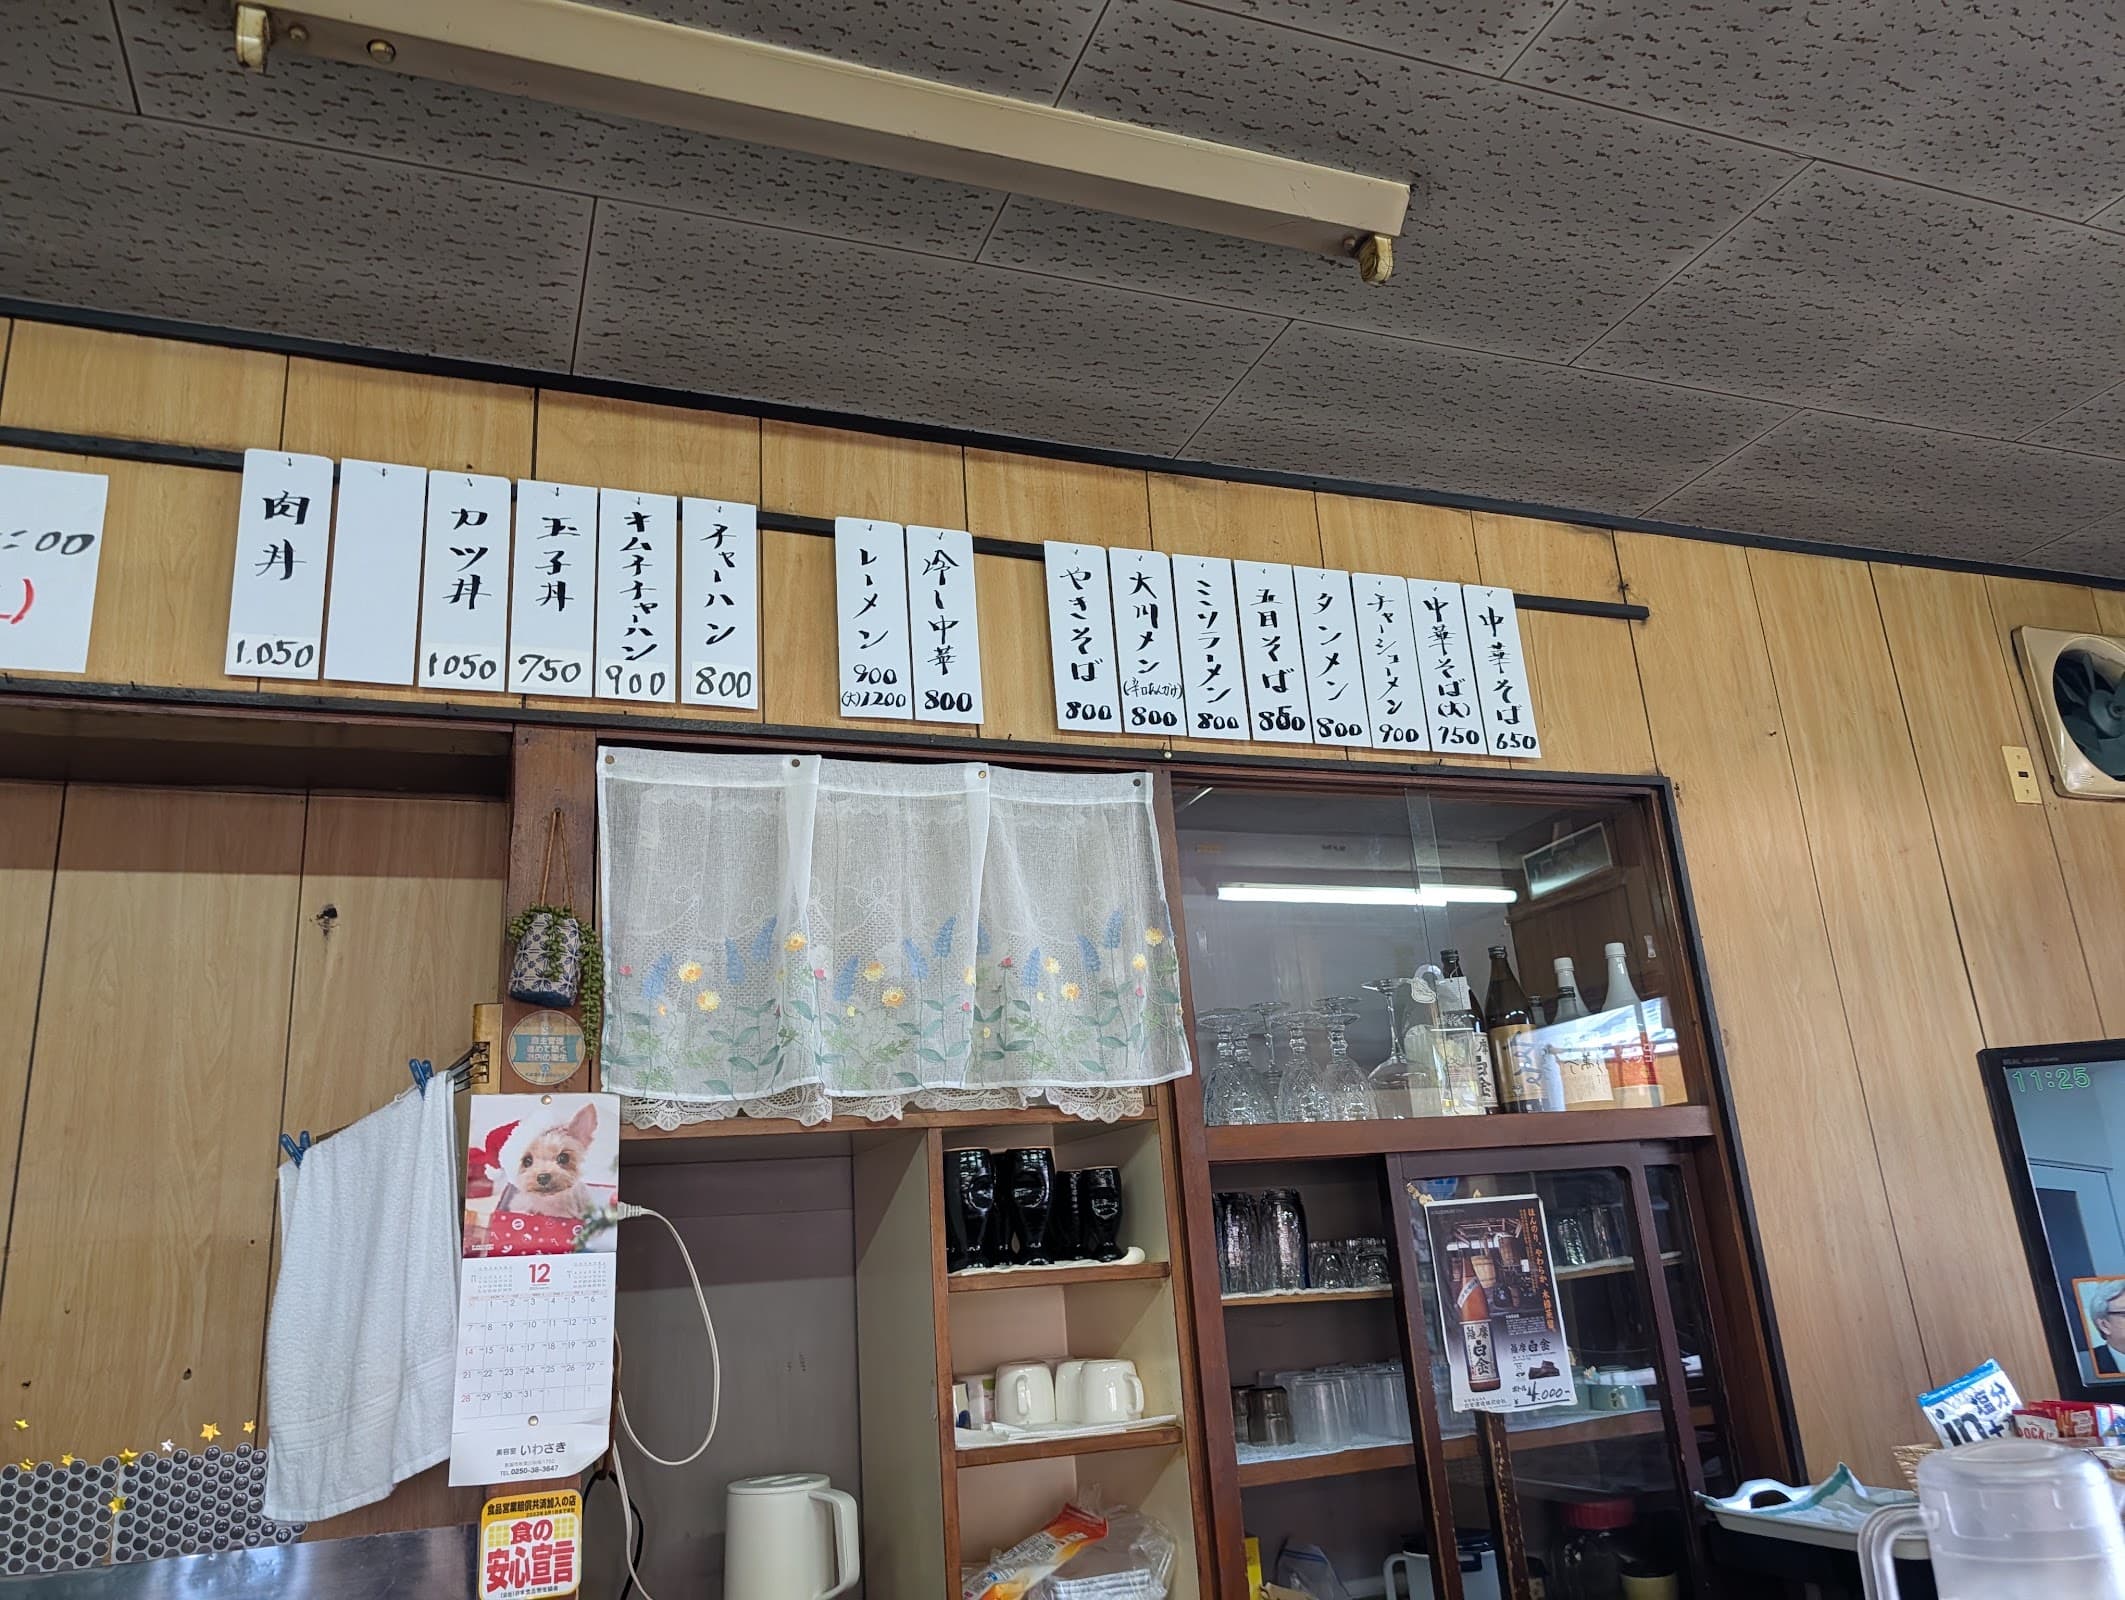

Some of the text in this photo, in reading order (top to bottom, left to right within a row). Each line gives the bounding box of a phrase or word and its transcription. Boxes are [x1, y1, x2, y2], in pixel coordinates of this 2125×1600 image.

[255, 490, 310, 580] 肉丼
[444, 509, 490, 610] カツ丼
[536, 517, 580, 611] 玉子丼
[620, 512, 658, 660] キムチチャーハン
[700, 523, 737, 646] チャーハン
[852, 548, 889, 650] レーメン
[1060, 567, 1103, 681] やきそば
[1130, 572, 1159, 673] 大川メン
[1250, 588, 1295, 694] 五目そば
[1314, 592, 1350, 701] タンメン
[1367, 593, 1404, 714] チャーシューメン
[429, 653, 496, 679] 1050
[519, 655, 581, 682] 750
[854, 665, 897, 684] 900
[1479, 606, 1522, 724] 中華そば
[606, 666, 665, 695] 900
[696, 667, 751, 698] 800
[925, 690, 972, 712] 800
[1066, 702, 1112, 720] 800
[1132, 707, 1177, 726] 800
[1198, 713, 1239, 729] 800
[1317, 718, 1362, 737] 800
[1379, 724, 1419, 742] 900
[1438, 726, 1479, 744] 750
[1497, 732, 1536, 749] 650
[2012, 1067, 2090, 1092] 11:25
[528, 1263, 550, 1283] 12
[531, 1298, 535, 1306] 3
[1971, 1382, 2011, 1415] 塩分
[1935, 1408, 1989, 1447] in
[521, 1442, 566, 1455] いわさき
[511, 1519, 553, 1544] 食の
[487, 1540, 574, 1593] 安心宣言
